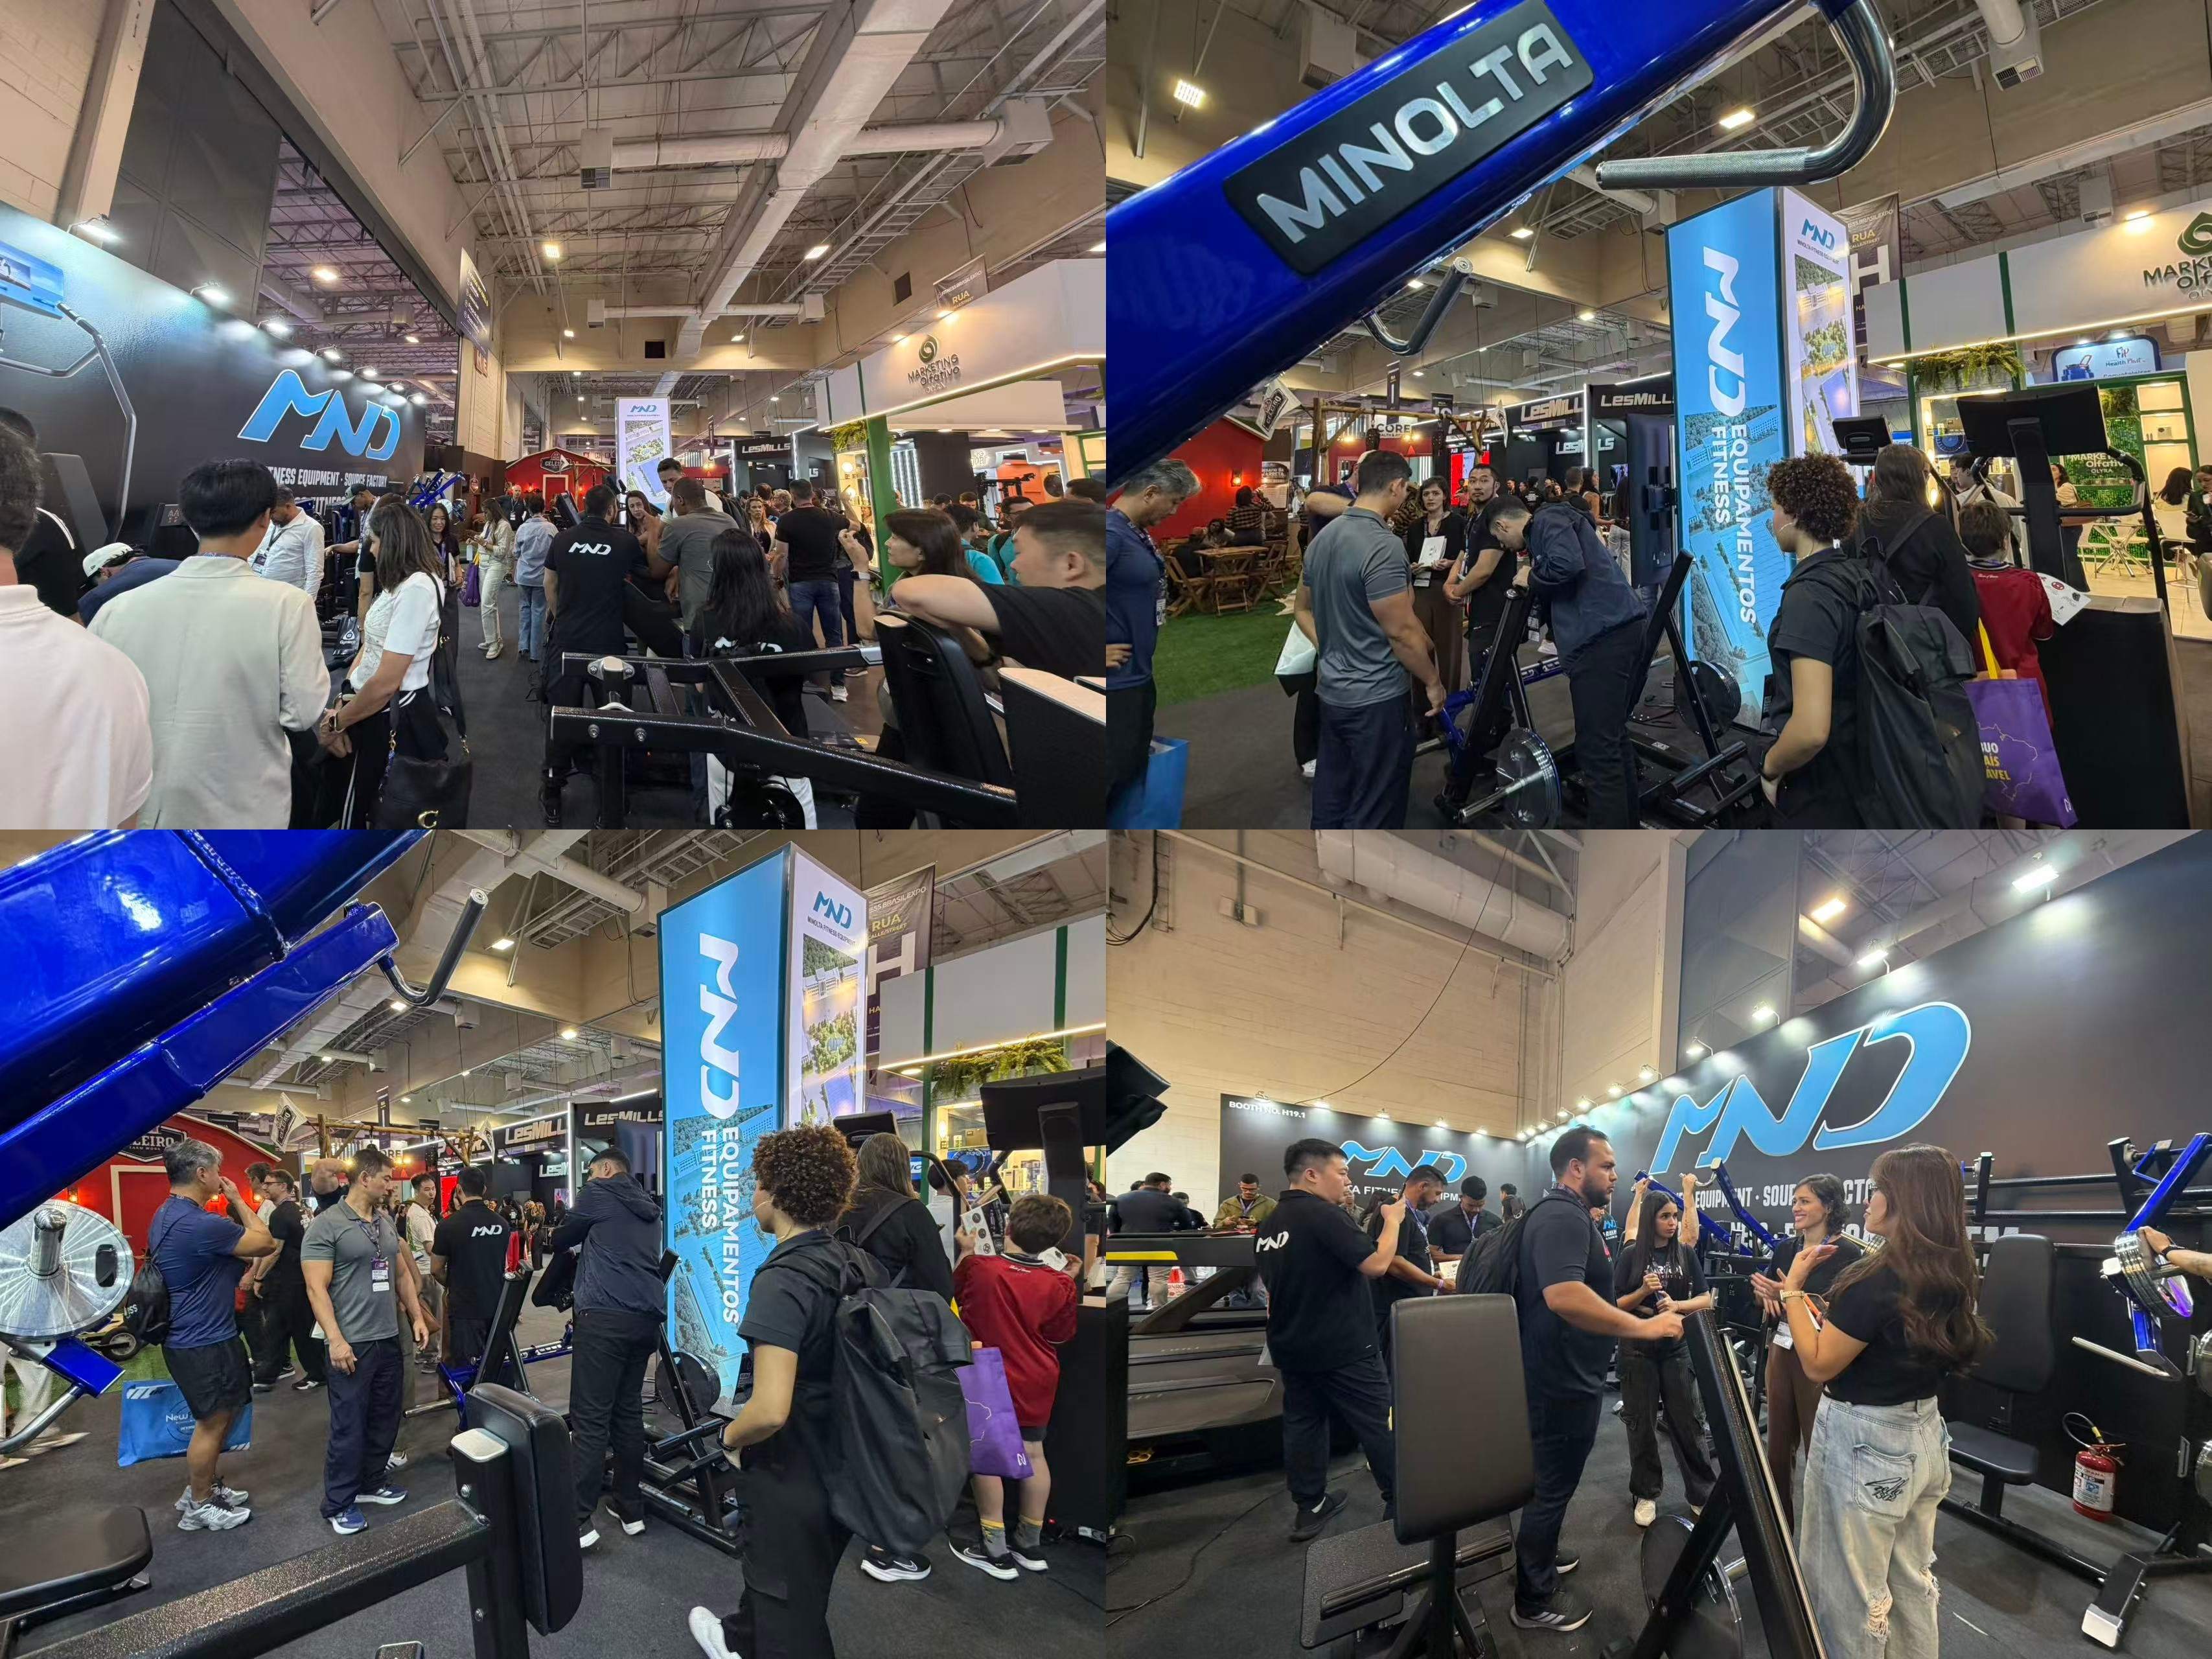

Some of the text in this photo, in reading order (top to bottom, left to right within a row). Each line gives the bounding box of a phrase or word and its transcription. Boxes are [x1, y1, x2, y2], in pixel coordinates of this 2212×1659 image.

[1256, 22, 1574, 244] MINOLTA
[1801, 218, 1836, 251] MND
[1852, 229, 1876, 243] RUA
[952, 290, 970, 305] RUA
[1703, 246, 1746, 417] MND
[908, 354, 959, 382] MARKETING
[237, 369, 400, 461] MND
[1377, 423, 1411, 433] CORE
[297, 469, 340, 487] EQUIPMENT
[366, 474, 388, 487] FACTORY
[1711, 426, 1730, 525] FITNESS
[1730, 424, 1756, 625] EQUIPAMENTOS
[568, 542, 612, 555] MND
[812, 890, 852, 929] MND
[882, 895, 906, 909] BRASIL
[906, 886, 927, 901] EXPO
[807, 916, 824, 929] MINOLTA
[871, 913, 901, 932] RUA
[867, 931, 916, 996] H
[699, 933, 740, 1120] MND
[1648, 1001, 1972, 1175] MND
[1229, 1101, 1306, 1119] BOOTH NO. H19.1
[701, 1130, 718, 1230] FITNESS
[1696, 1186, 1753, 1211] EQUIPMNT
[471, 1224, 502, 1237] MND
[722, 1127, 739, 1325] EQUIPAMENTOS
[1256, 1231, 1289, 1253] MND
